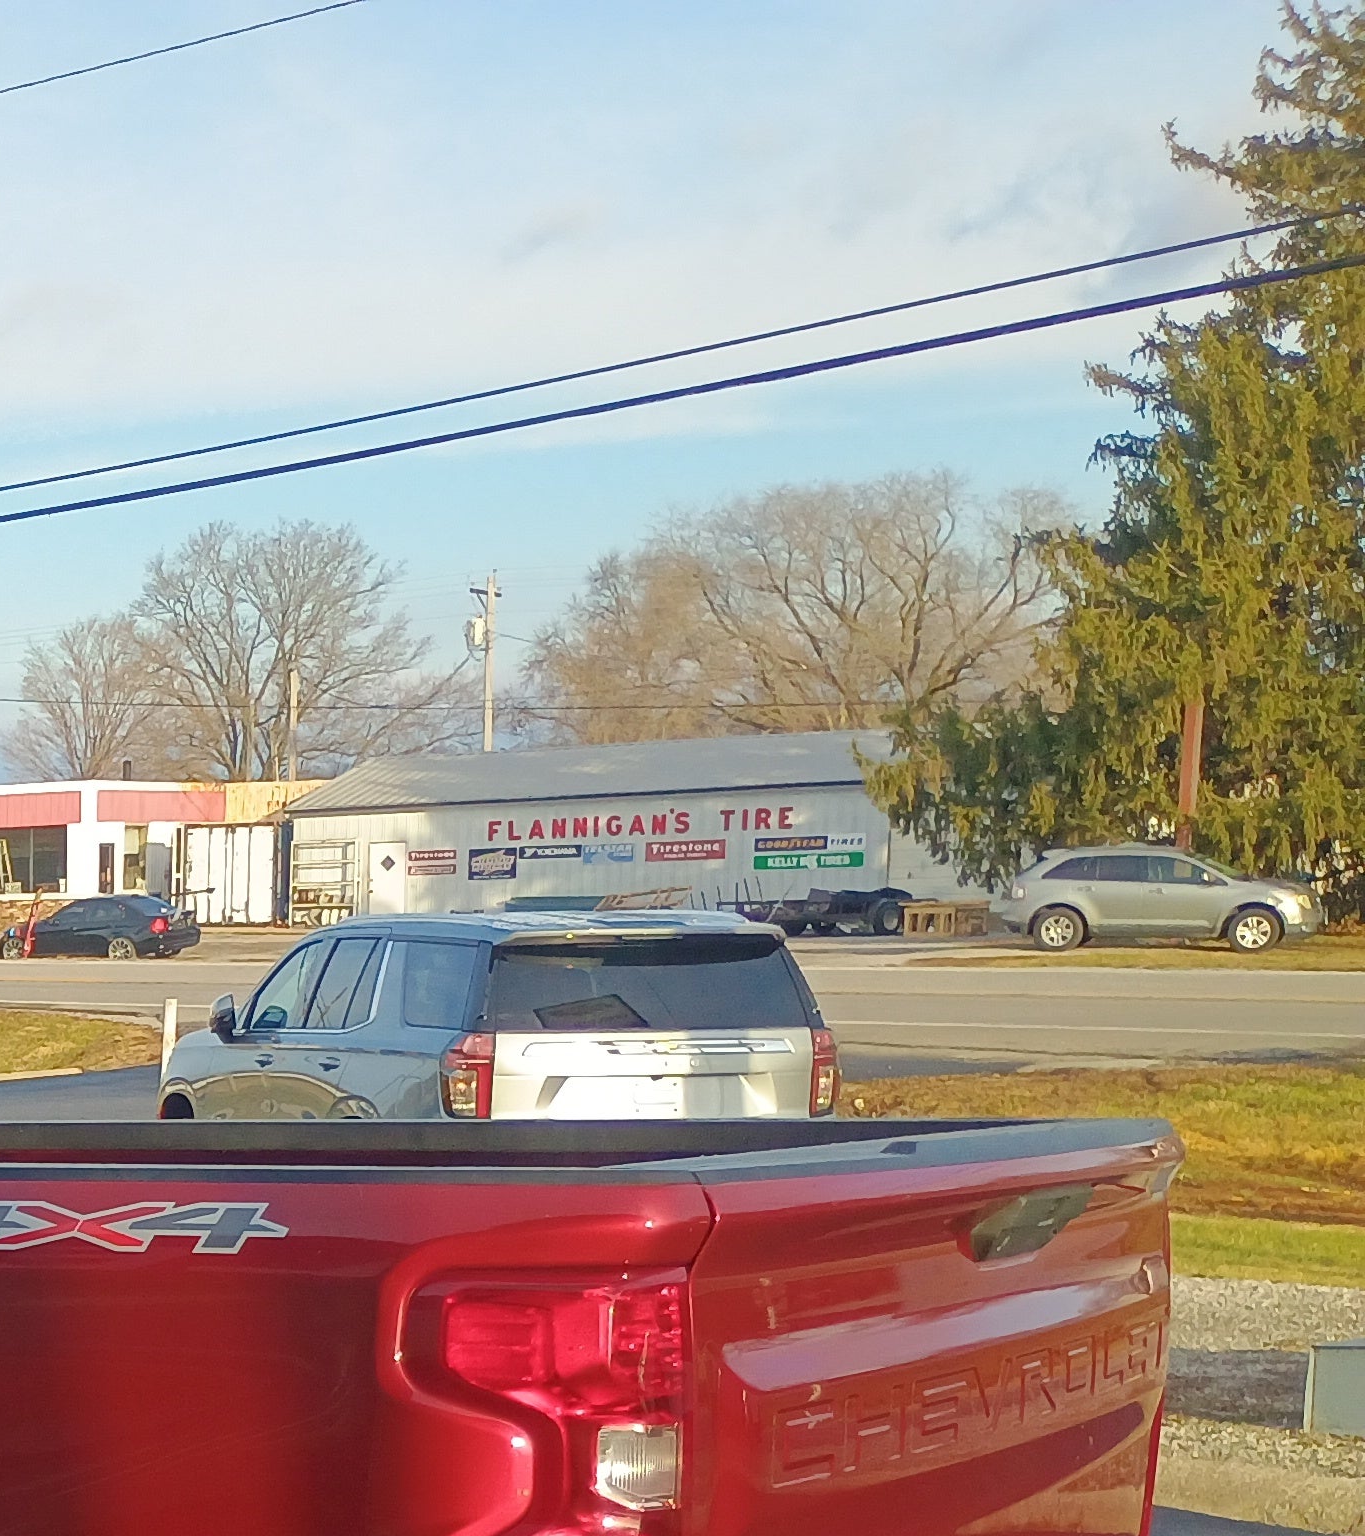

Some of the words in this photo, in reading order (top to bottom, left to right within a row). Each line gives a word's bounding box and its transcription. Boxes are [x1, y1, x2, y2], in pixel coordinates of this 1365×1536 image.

[487, 808, 690, 842] FLANNIGAN'S
[720, 806, 794, 831] TIRE
[651, 842, 720, 855] Firestone
[757, 839, 825, 849] GOODYEAR
[830, 837, 863, 846] TIRES
[767, 857, 799, 867] KELLY
[771, 1320, 1162, 1489] CHEVROLET
